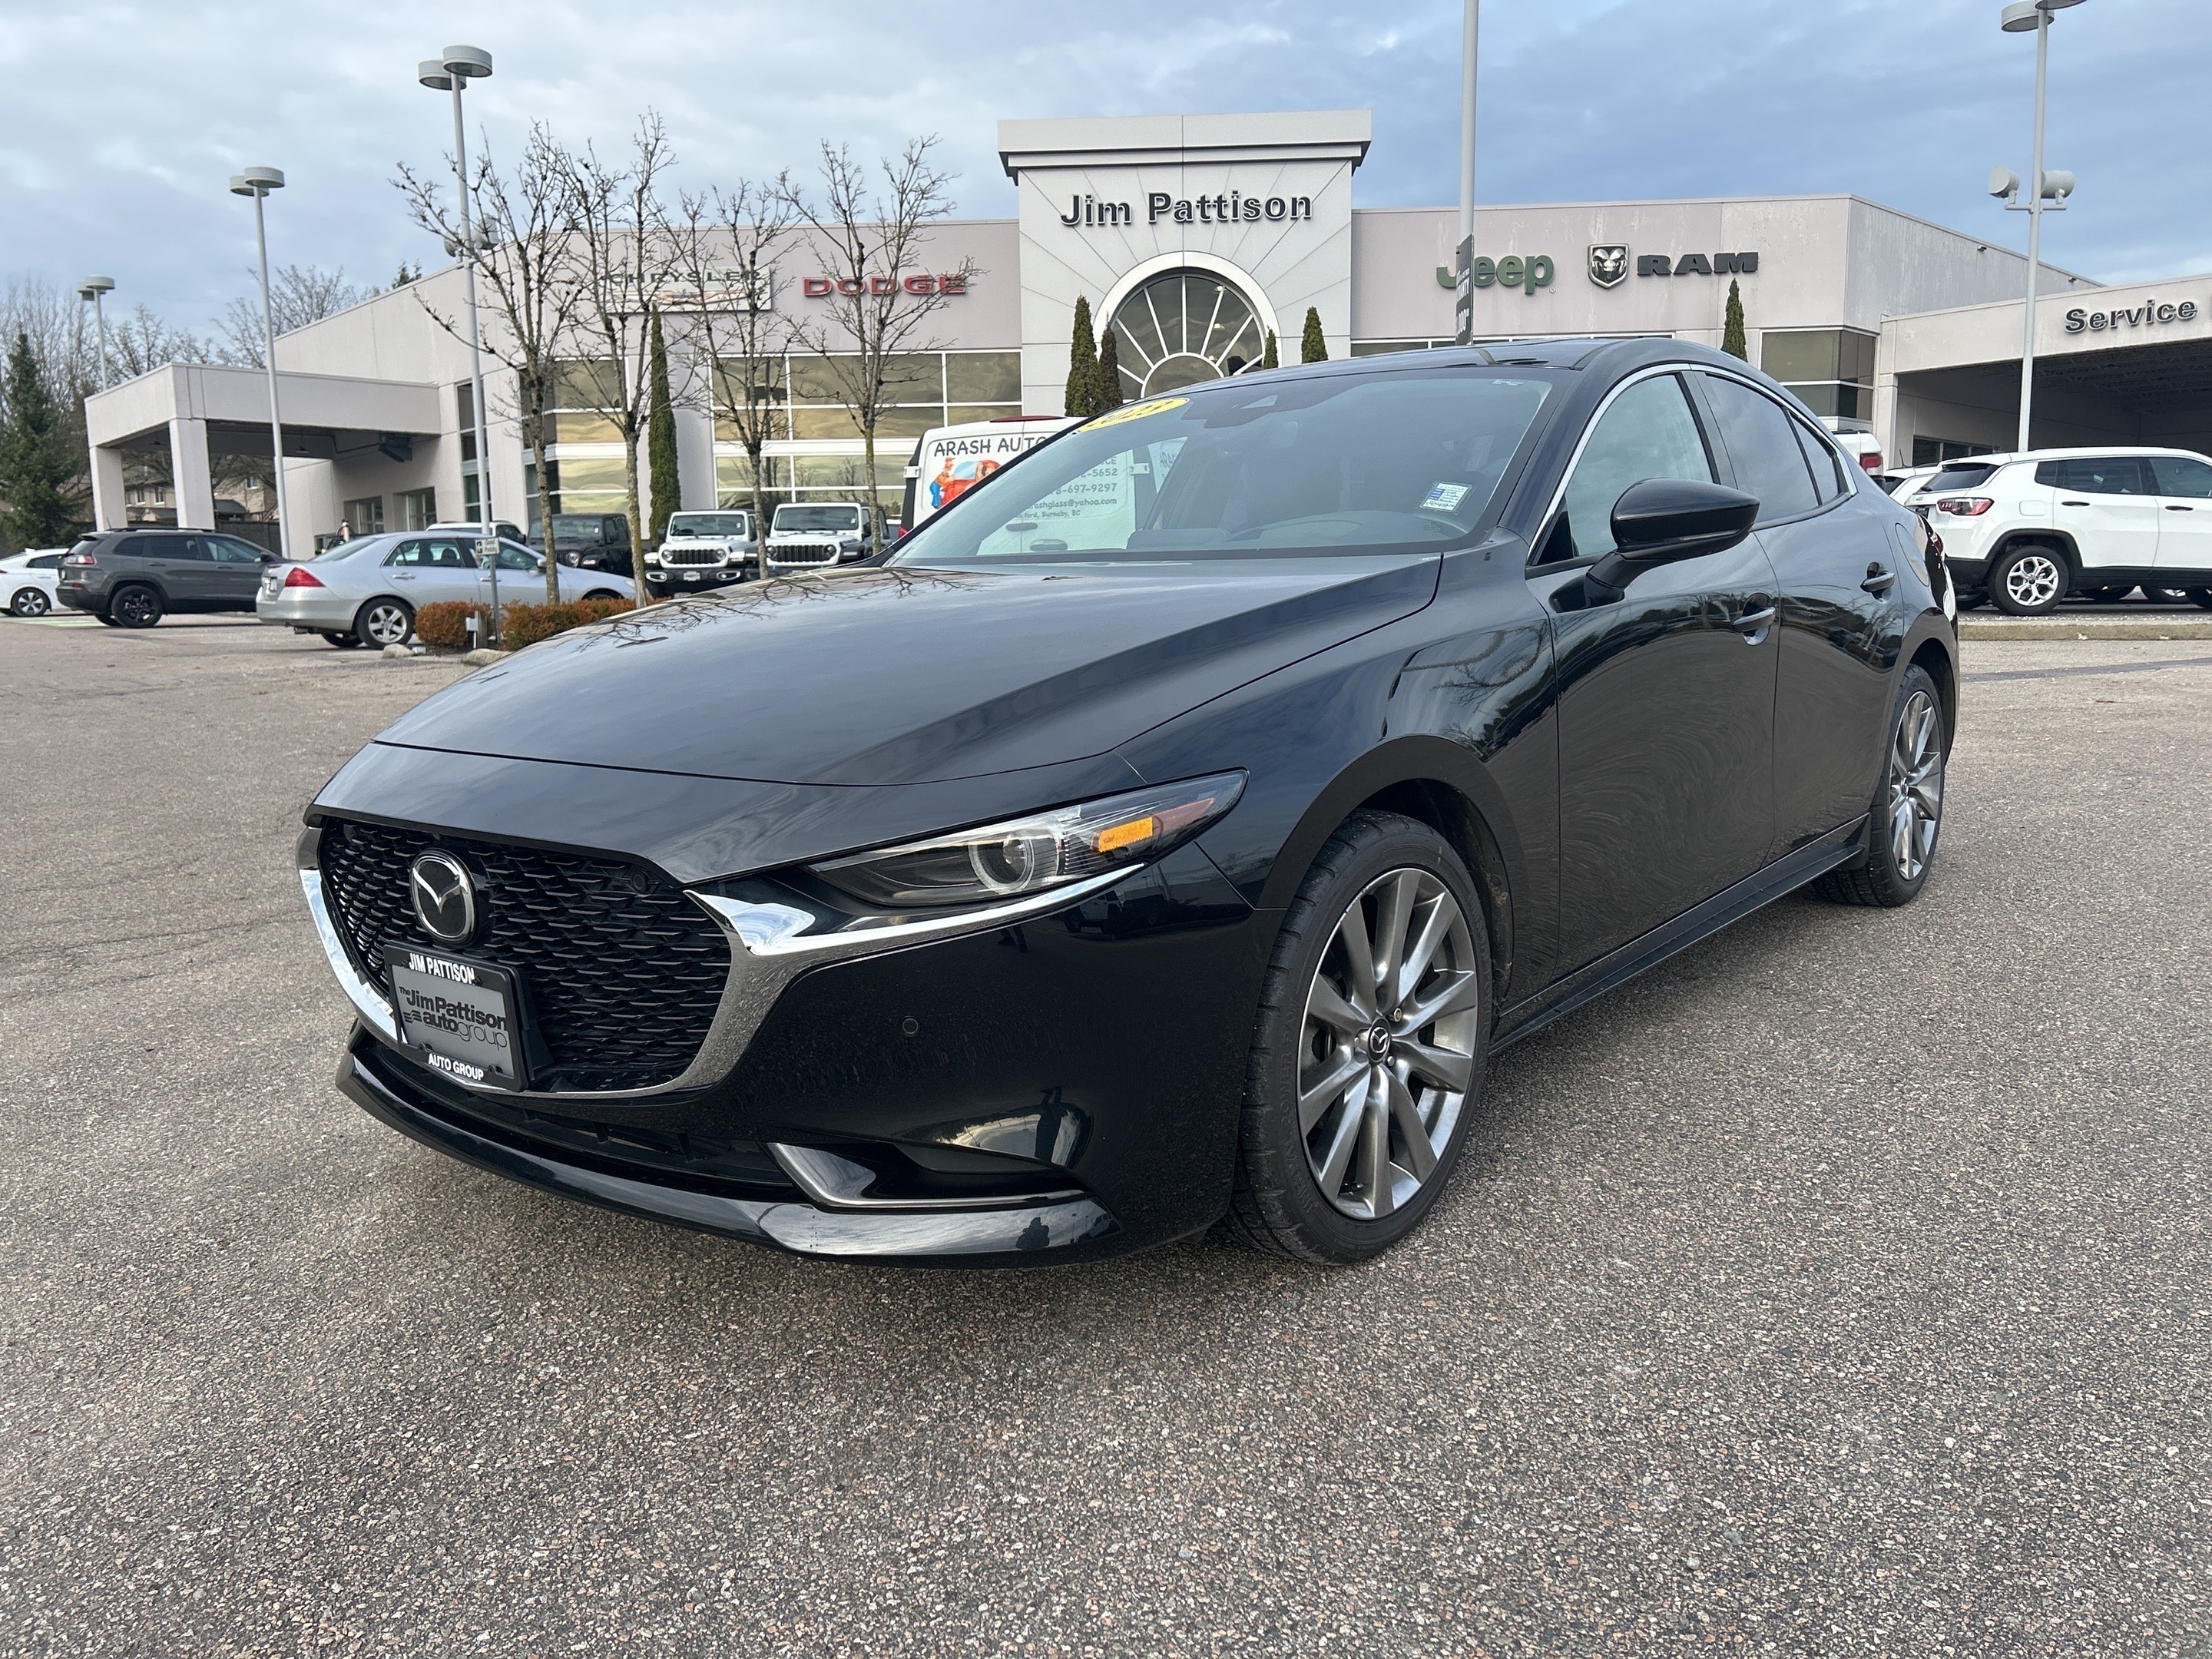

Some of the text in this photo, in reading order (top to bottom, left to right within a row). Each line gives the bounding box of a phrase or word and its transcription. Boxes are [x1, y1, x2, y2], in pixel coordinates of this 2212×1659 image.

[1061, 190, 1313, 226] Jim Pattison
[1637, 251, 1759, 276] RAM
[803, 275, 966, 296] DODGE
[2065, 299, 2198, 333] Service
[934, 439, 992, 457] ARASH
[1081, 468, 1118, 478] -5652
[1051, 483, 1118, 495] 8-697-9297
[409, 952, 476, 985] JIM PATTISON
[399, 986, 411, 996] The
[429, 1053, 485, 1081] AUTO GROUP
